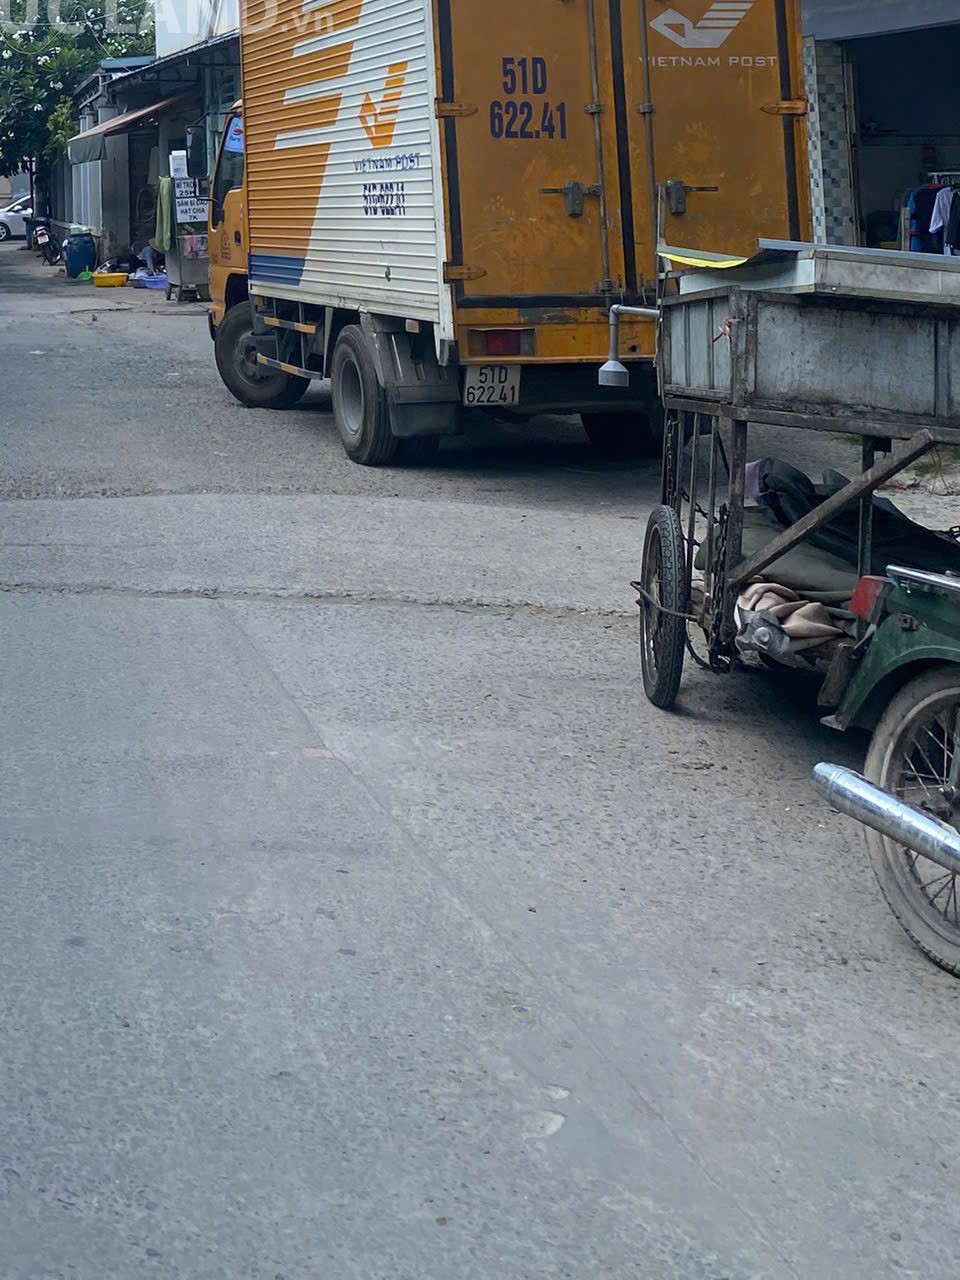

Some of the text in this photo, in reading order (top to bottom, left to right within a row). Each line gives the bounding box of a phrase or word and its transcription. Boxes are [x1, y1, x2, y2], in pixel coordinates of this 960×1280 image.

[728, 56, 778, 67] POST
[502, 57, 547, 95] 51D
[489, 100, 567, 139] 622.41
[479, 366, 508, 384] 51D
[466, 385, 516, 403] 622.41
